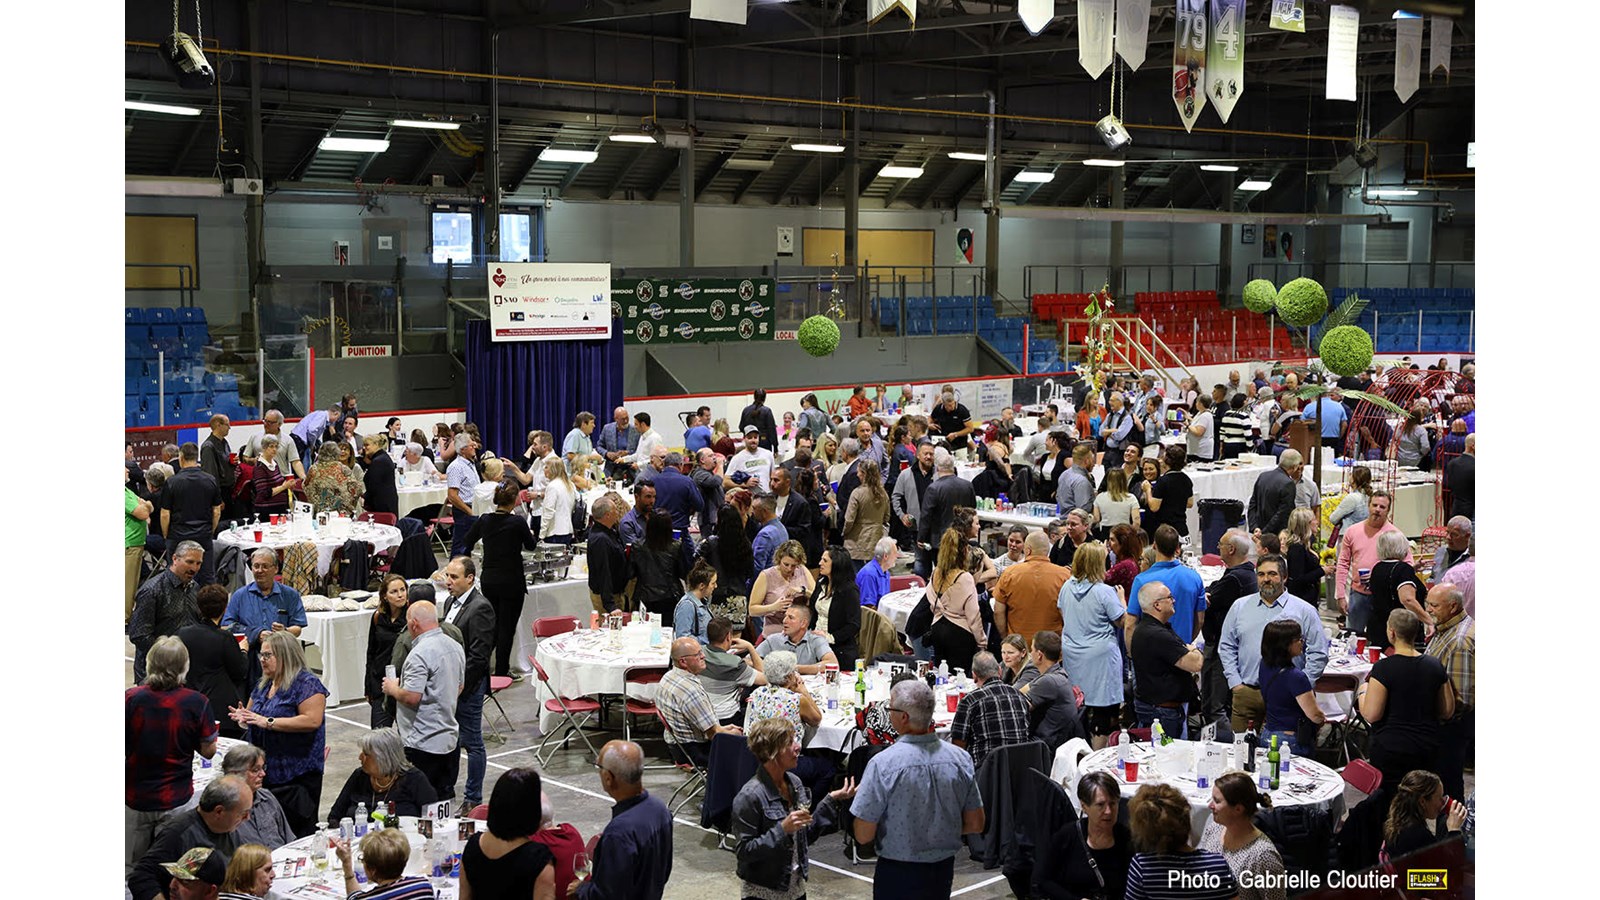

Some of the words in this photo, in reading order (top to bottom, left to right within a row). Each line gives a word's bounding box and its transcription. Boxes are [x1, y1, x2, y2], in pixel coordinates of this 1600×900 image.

[1179, 10, 1207, 51] 79
[1215, 4, 1240, 60] 4
[776, 331, 795, 339] LOCAL
[347, 346, 386, 356] PUNITION
[302, 504, 311, 513] 3
[891, 665, 905, 678] 57
[437, 802, 450, 820] 60
